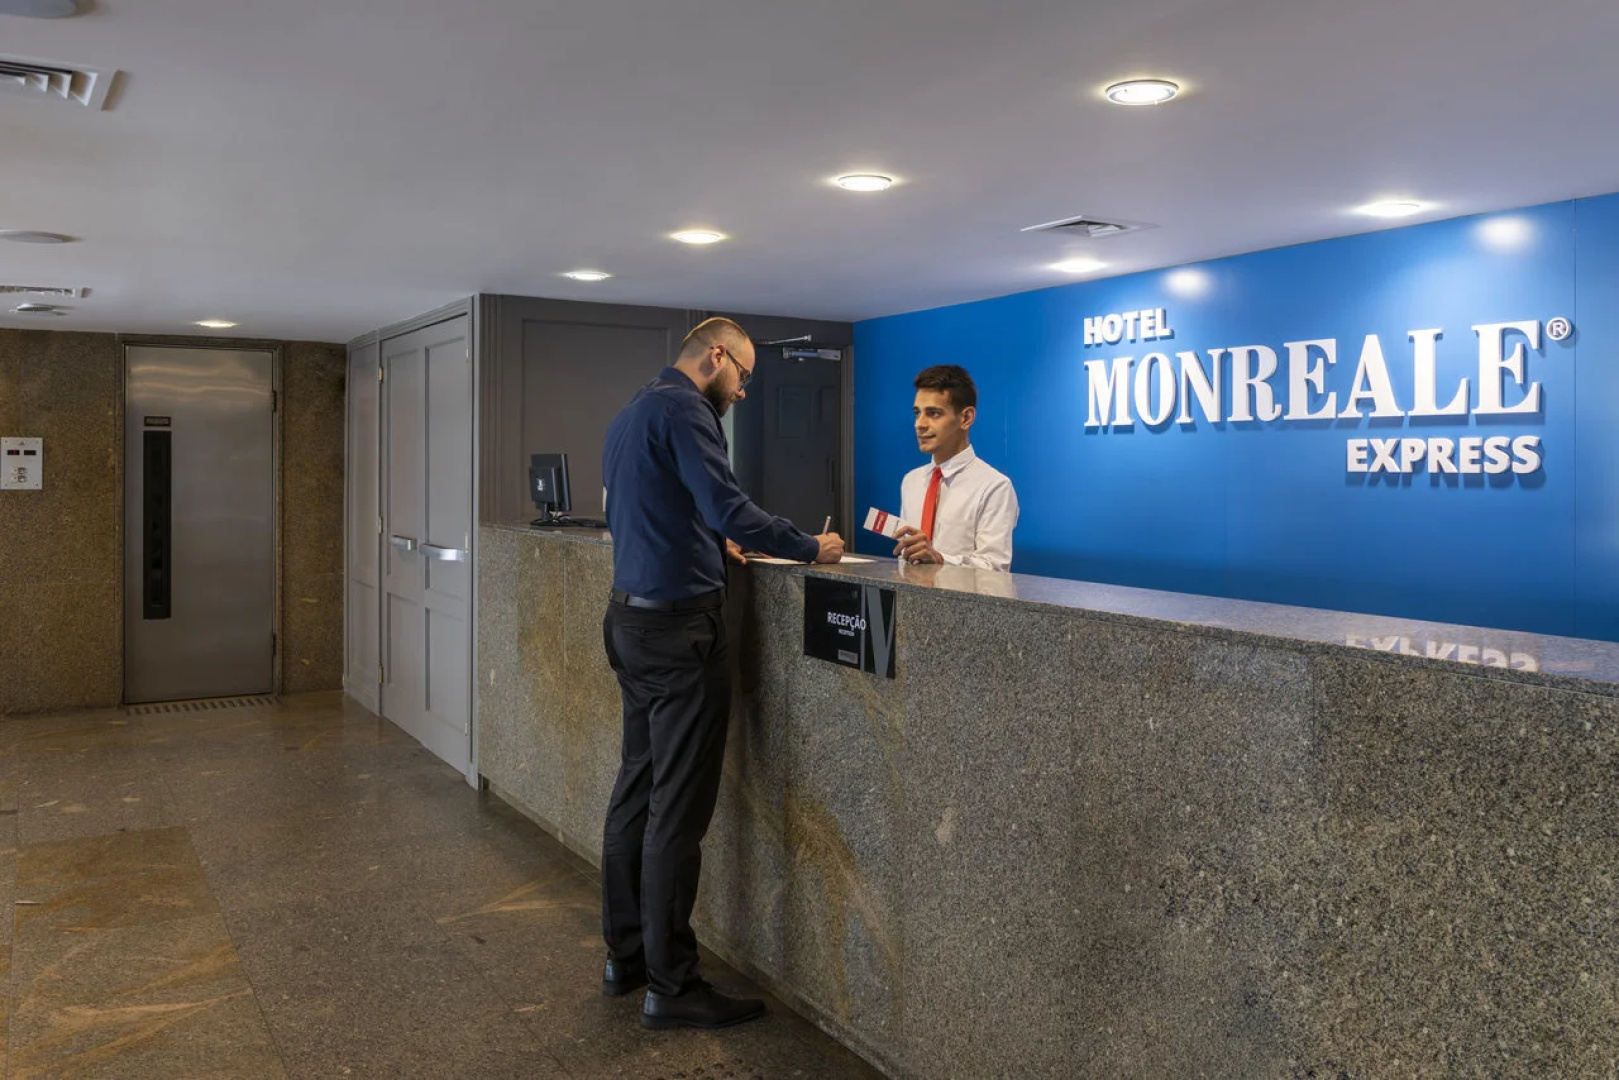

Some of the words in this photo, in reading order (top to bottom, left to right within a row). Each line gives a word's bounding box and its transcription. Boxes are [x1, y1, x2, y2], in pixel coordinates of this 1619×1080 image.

[1084, 308, 1172, 345] HOTEL
[1084, 320, 1540, 427] MONREALE
[1346, 435, 1541, 474] EXPRESS
[827, 612, 866, 631] RECEPÇÃO
